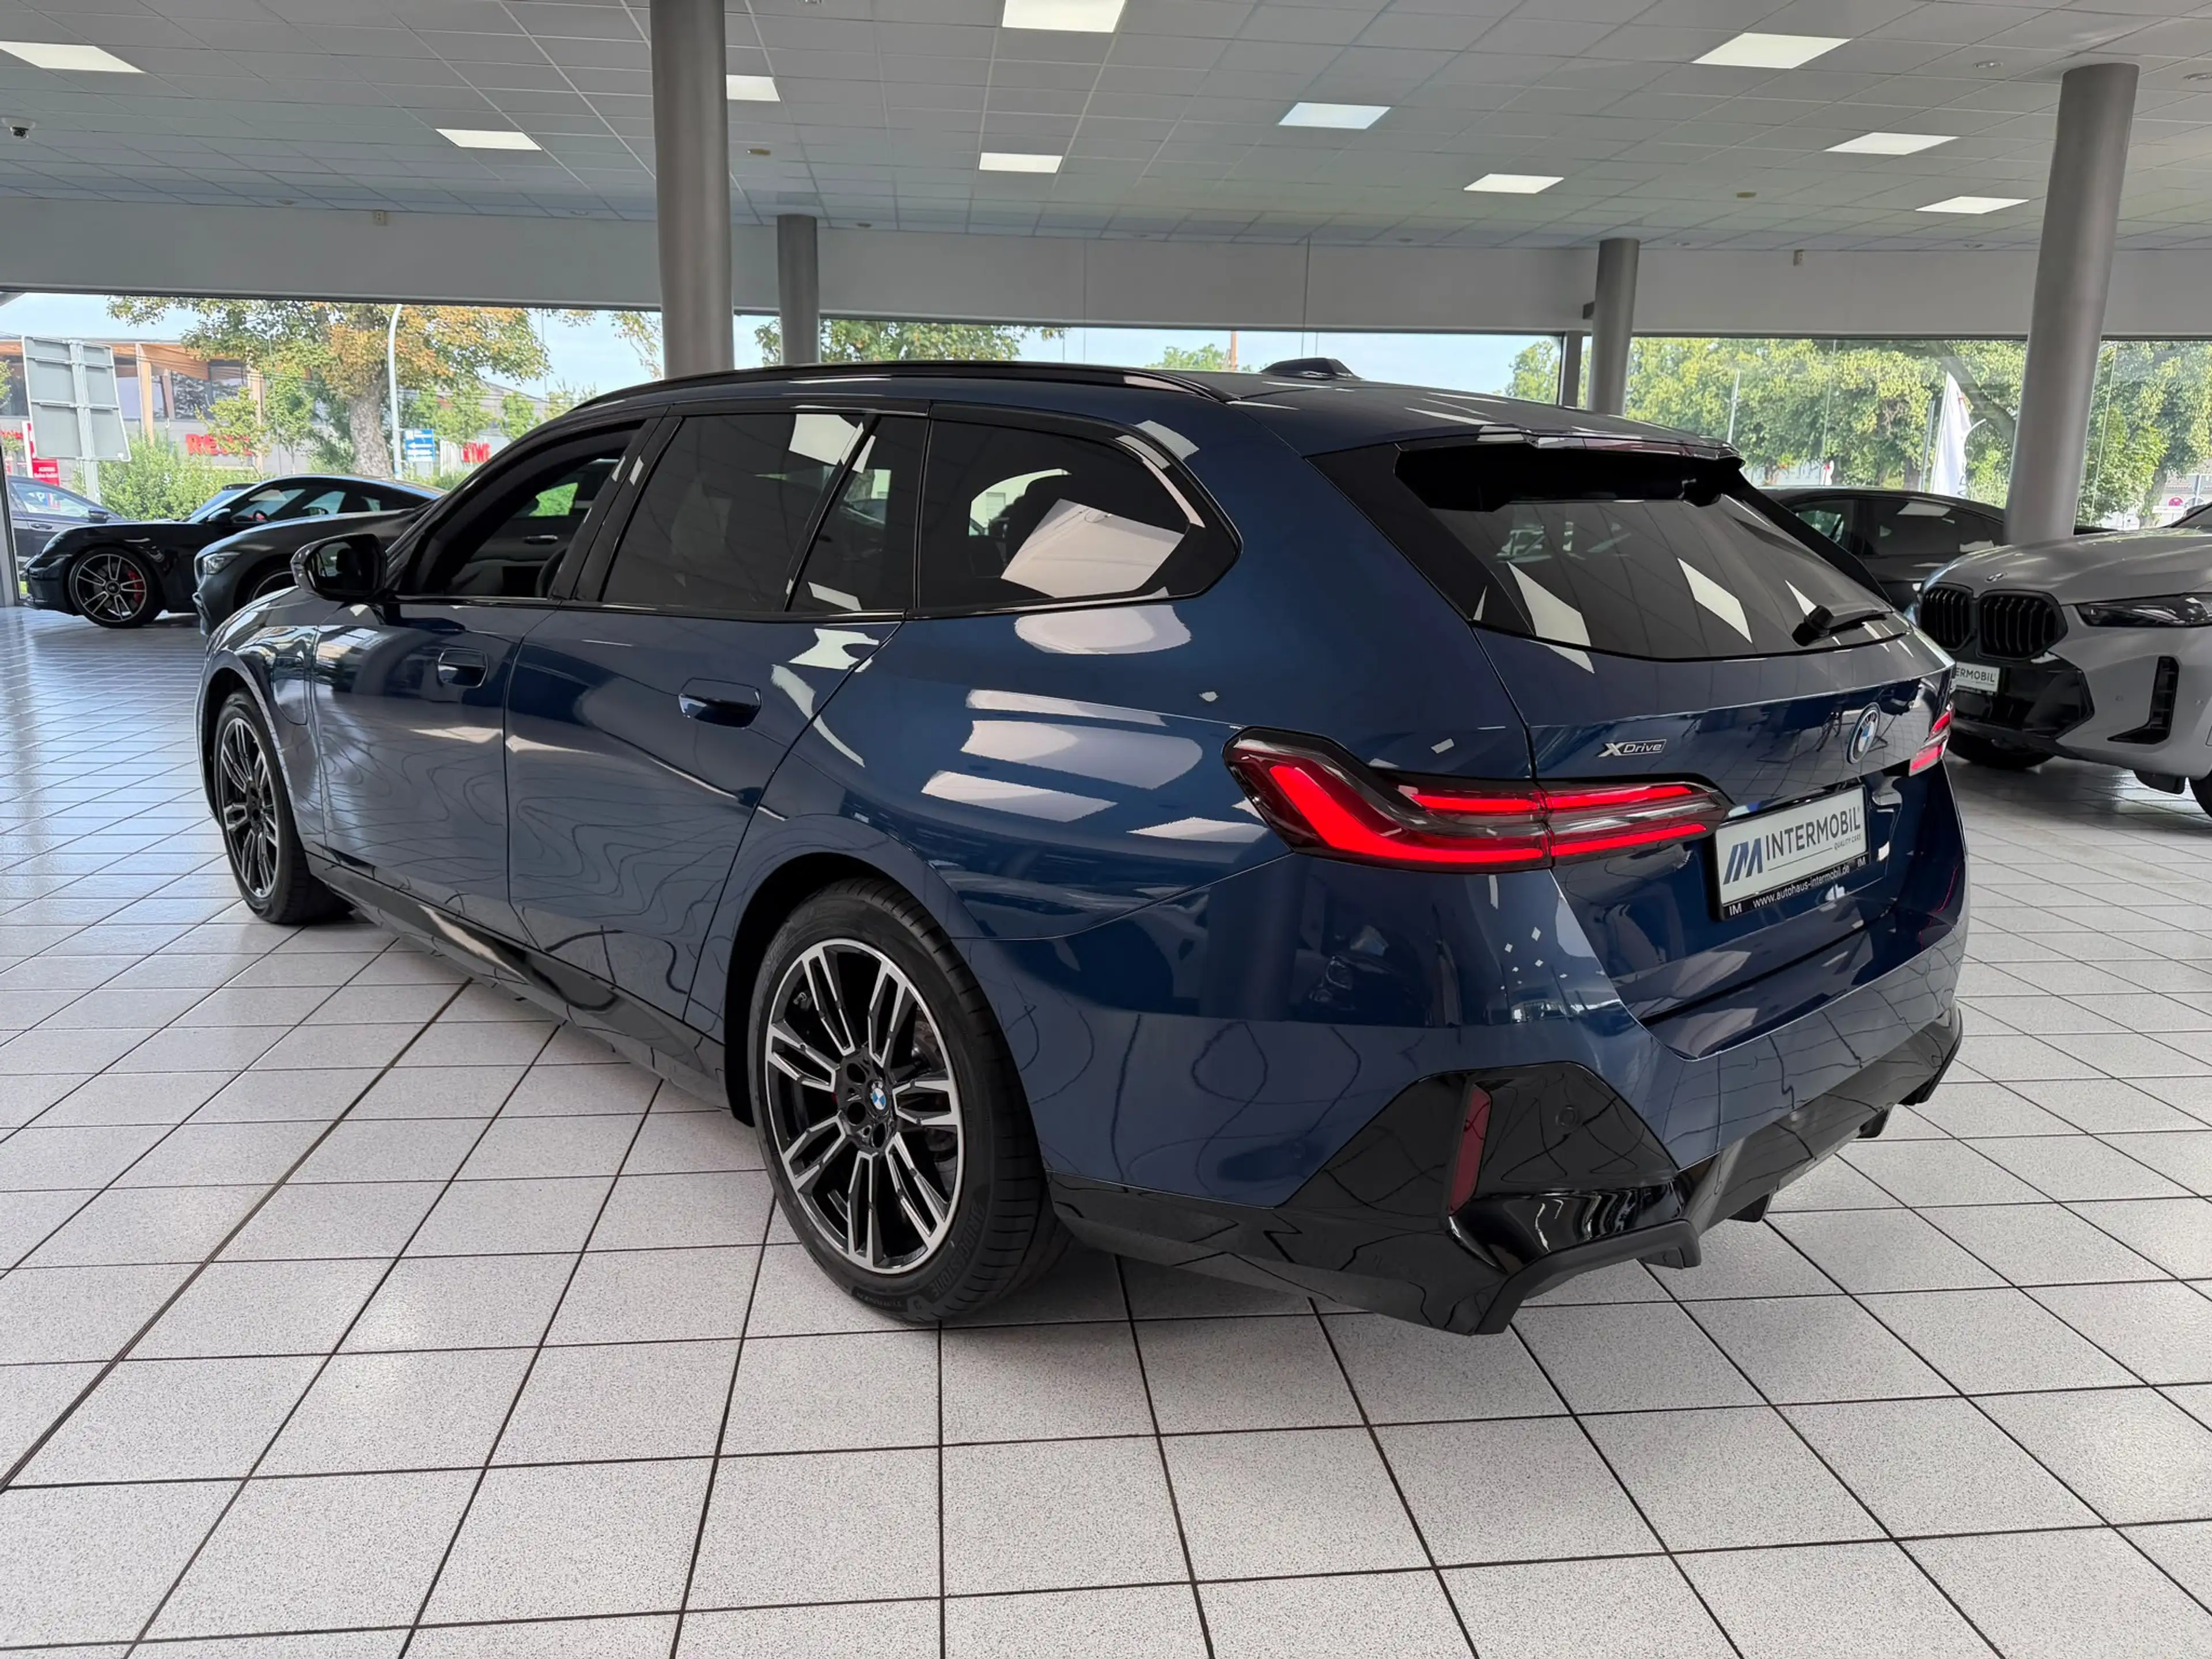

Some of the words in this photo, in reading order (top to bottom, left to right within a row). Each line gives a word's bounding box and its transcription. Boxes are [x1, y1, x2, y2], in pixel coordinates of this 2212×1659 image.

[185, 433, 253, 456] RE
[1729, 903, 1743, 916] IM
[1752, 865, 1850, 908] www.autohaus-intermobil.de
